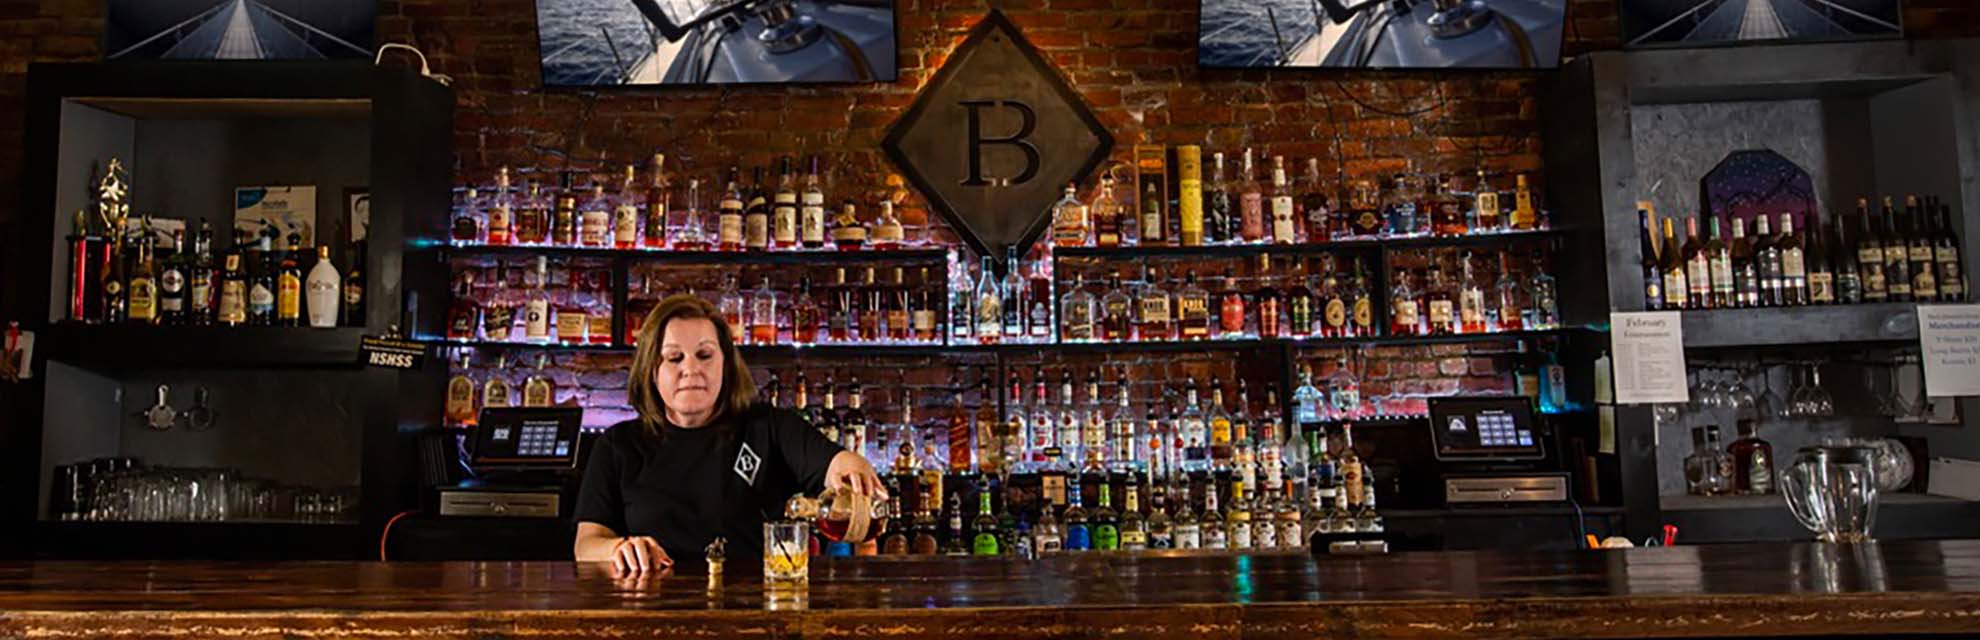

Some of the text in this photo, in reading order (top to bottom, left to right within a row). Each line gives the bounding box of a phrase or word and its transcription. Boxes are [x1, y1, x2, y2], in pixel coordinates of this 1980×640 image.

[957, 98, 1041, 187] B
[1626, 318, 1666, 328] February
[369, 351, 414, 368] NSHSS
[740, 454, 754, 471] B
